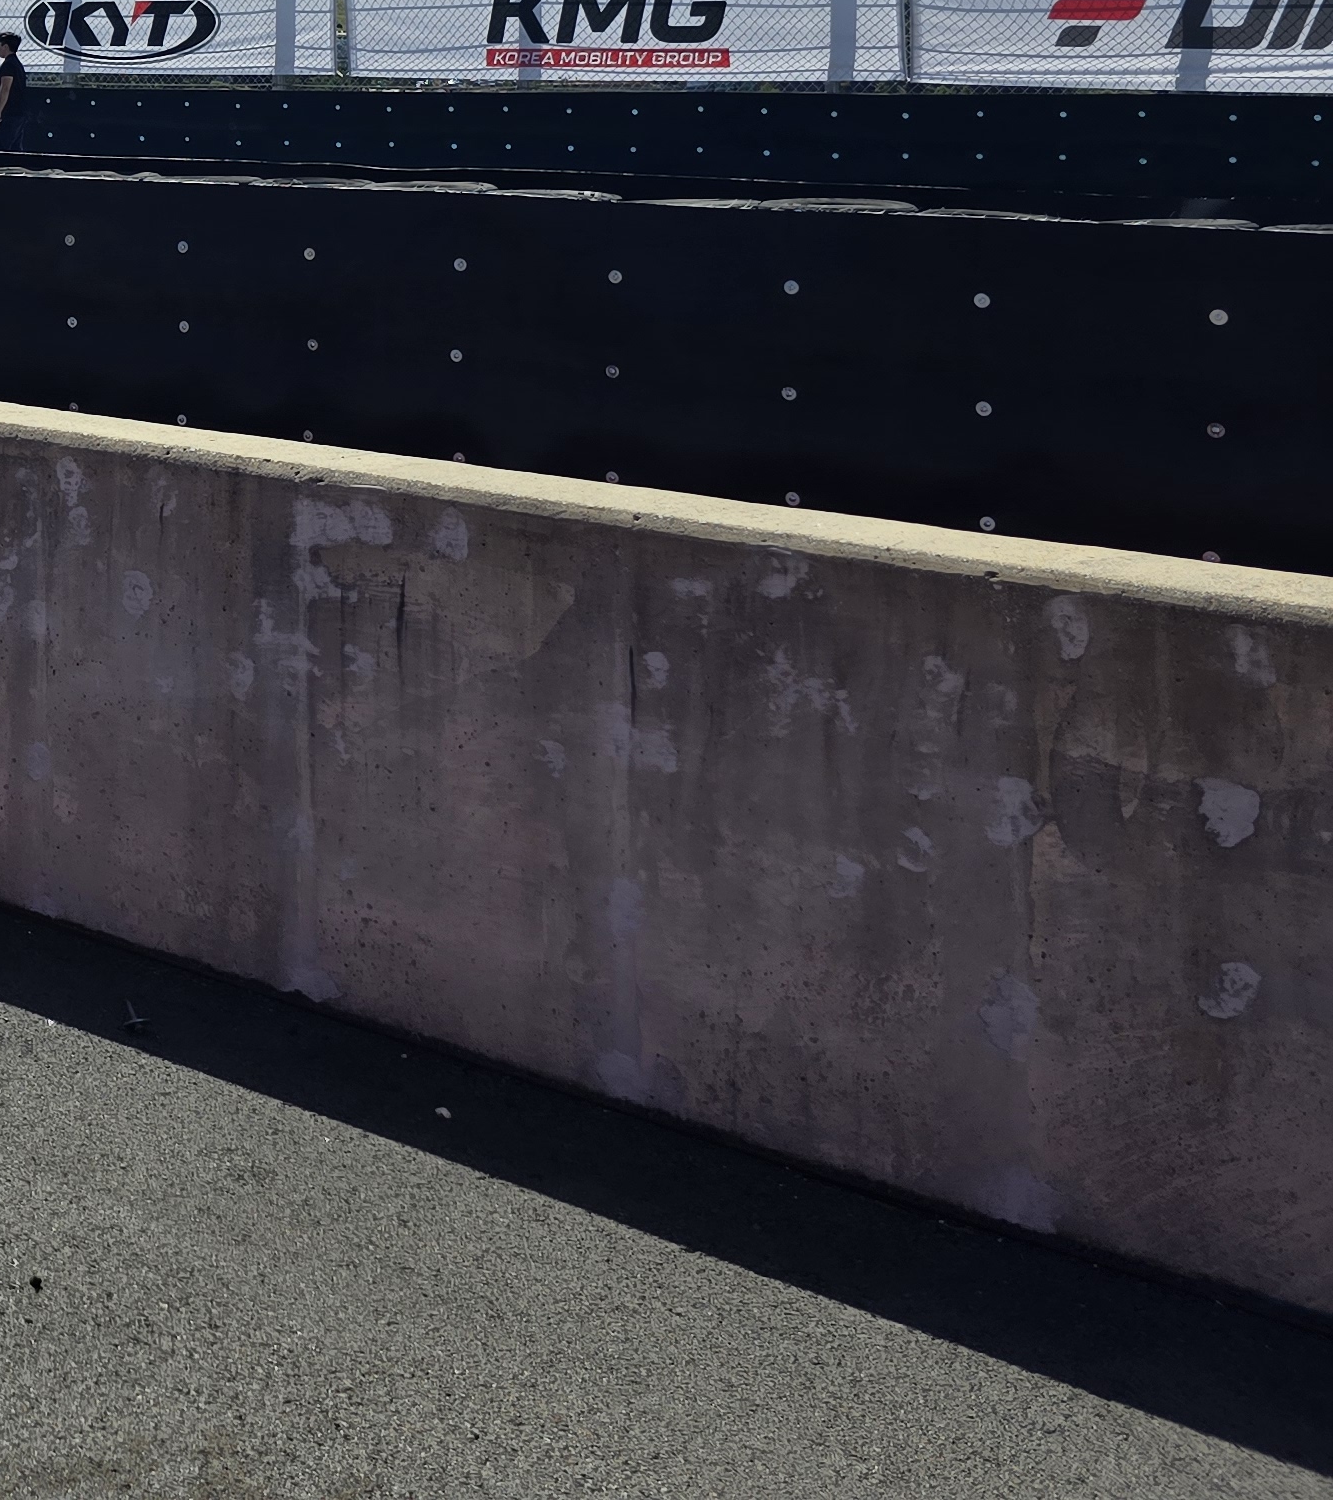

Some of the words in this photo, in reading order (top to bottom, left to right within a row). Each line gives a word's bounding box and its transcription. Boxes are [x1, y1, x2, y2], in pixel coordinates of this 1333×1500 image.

[47, 0, 202, 48] KYT
[493, 50, 555, 66] KOREA
[557, 50, 647, 67] MOBILITY
[651, 51, 722, 67] GROUP
